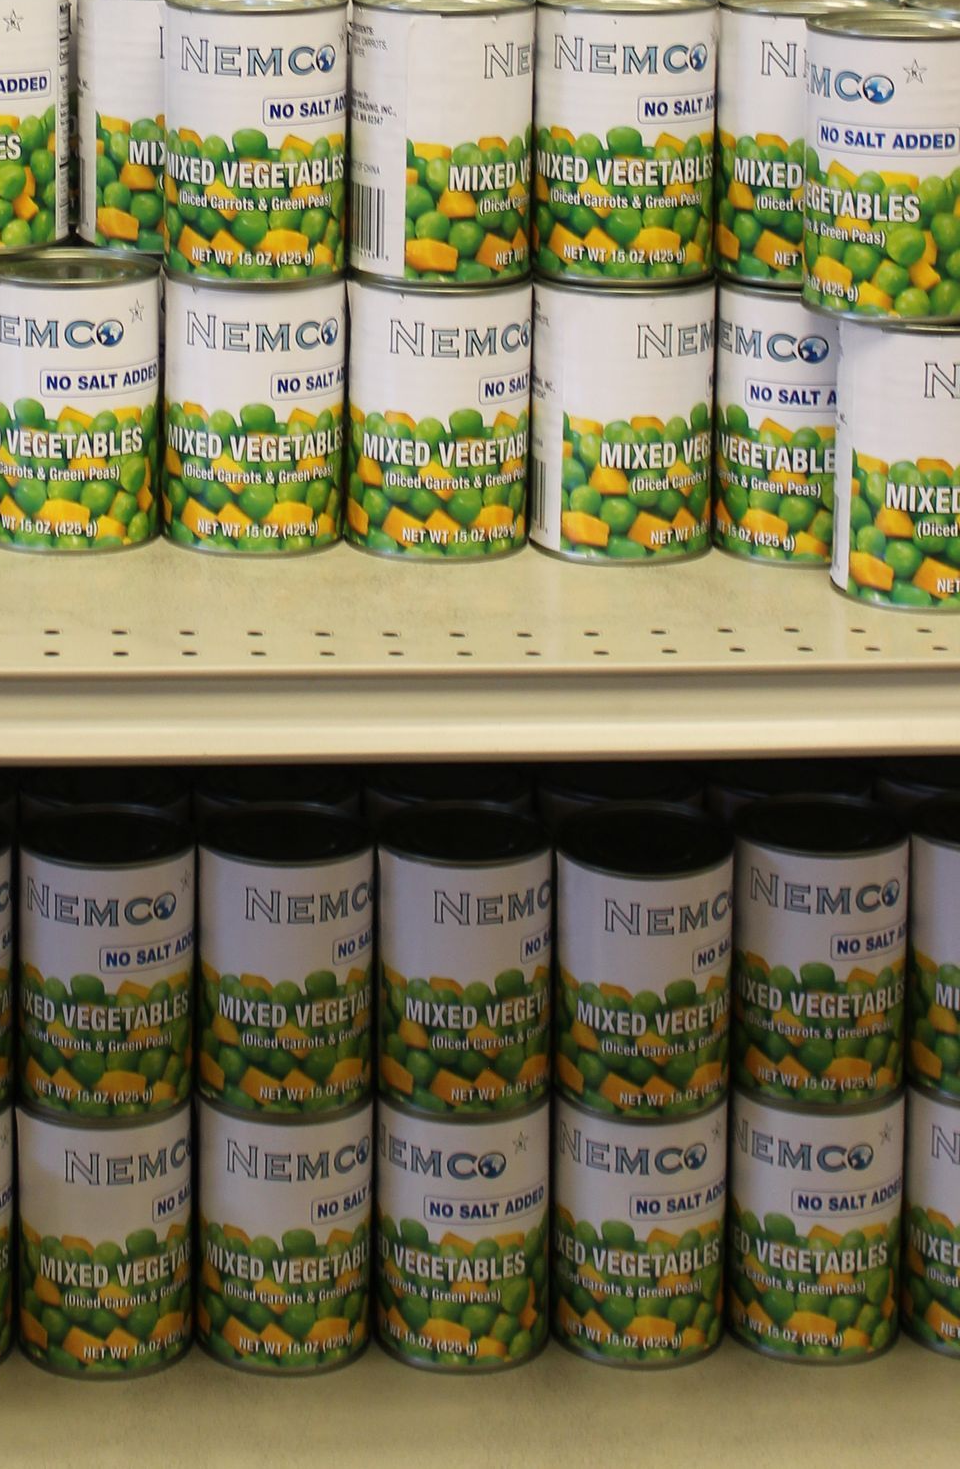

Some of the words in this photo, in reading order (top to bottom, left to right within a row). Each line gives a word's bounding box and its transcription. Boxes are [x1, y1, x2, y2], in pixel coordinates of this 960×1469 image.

[180, 34, 337, 78] NEMCO
[554, 34, 708, 76] NEMCO
[269, 103, 294, 119] NO
[300, 100, 331, 118] SALT
[644, 98, 668, 118] NO
[673, 98, 703, 116] SALT
[820, 125, 840, 143] NO
[844, 130, 885, 148] SALT
[892, 132, 955, 150] ADDED
[167, 151, 215, 185] MIXED
[222, 154, 344, 190] VEGETABLES
[448, 160, 516, 192] MIXED
[537, 151, 588, 184] MIXED
[734, 158, 803, 187] MIXED
[179, 189, 208, 209] (Diced
[210, 194, 255, 211] Carrots
[271, 196, 305, 211] Green
[550, 187, 581, 205] (Diced
[584, 193, 628, 210] Carrots
[645, 195, 677, 210] Green
[820, 223, 849, 241] Green
[852, 229, 886, 247] Peas)
[191, 246, 211, 262] NET
[215, 250, 234, 265] WT
[256, 252, 273, 266] OZ
[564, 245, 584, 261] NET
[587, 248, 607, 262] WT
[630, 249, 645, 263] OZ
[186, 310, 339, 353] NEMCO
[46, 375, 71, 391] NO
[77, 374, 117, 391] SALT
[123, 364, 158, 387] ADDED
[277, 378, 301, 394] NO
[305, 372, 334, 391] SALT
[750, 384, 772, 403] NO
[778, 389, 821, 406] SALT
[6, 426, 143, 459] VEGETABLES
[169, 425, 223, 460] MIXED
[363, 428, 431, 467] MIXED
[600, 441, 677, 470] MIXED
[750, 477, 784, 494] Green
[787, 479, 822, 498] Peas)
[26, 876, 178, 927] NEMCO
[750, 866, 900, 915] NEMCO
[105, 952, 131, 968] NO
[136, 944, 171, 966] SALT
[62, 989, 189, 1031] VEGETABLES
[218, 993, 287, 1028] MIXED
[405, 996, 478, 1029] MIXED
[559, 1120, 707, 1176] NEMCO
[429, 1202, 454, 1218] NO
[459, 1203, 499, 1219] SALT
[505, 1185, 544, 1215] ADDED
[394, 1244, 526, 1283] VEGETABLES
[592, 1239, 720, 1278] VEGETABLES
[755, 1237, 888, 1275] VEGETABLES
